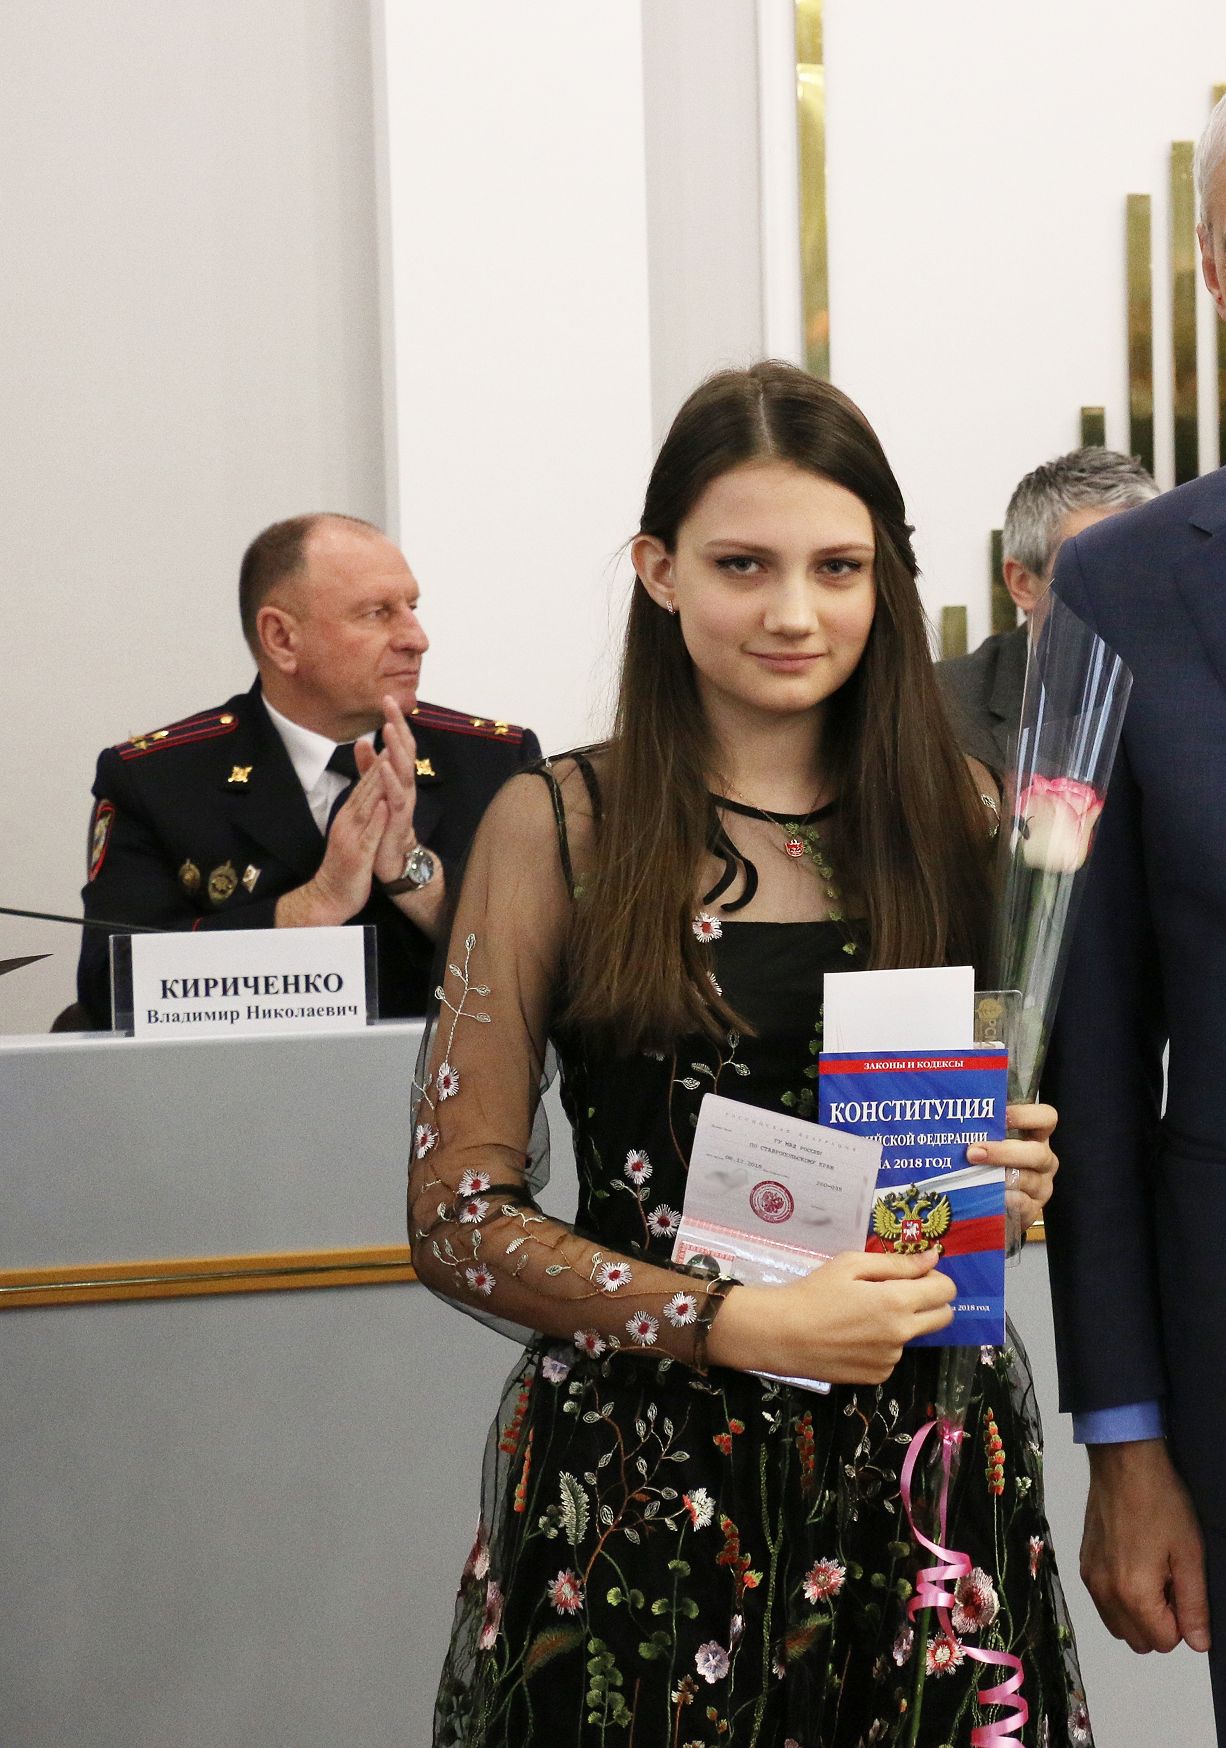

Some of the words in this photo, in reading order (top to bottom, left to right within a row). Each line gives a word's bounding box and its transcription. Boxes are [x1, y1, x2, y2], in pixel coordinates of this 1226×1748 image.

[160, 972, 344, 1000] КИРИЧЕНКО
[147, 1008, 240, 1024] Владимир
[246, 1004, 358, 1020] Николаевич
[864, 1062, 906, 1070] ЗАКОНЫ
[907, 1061, 915, 1069] И
[917, 1060, 964, 1069] КОДЕКСЫ
[829, 1097, 996, 1124] КОНСТИТУЦИЯ
[917, 1131, 988, 1146] ФЕДЕРАЦИИ
[879, 1159, 892, 1169] А
[894, 1158, 923, 1169] 2018
[925, 1156, 952, 1169] ГОД
